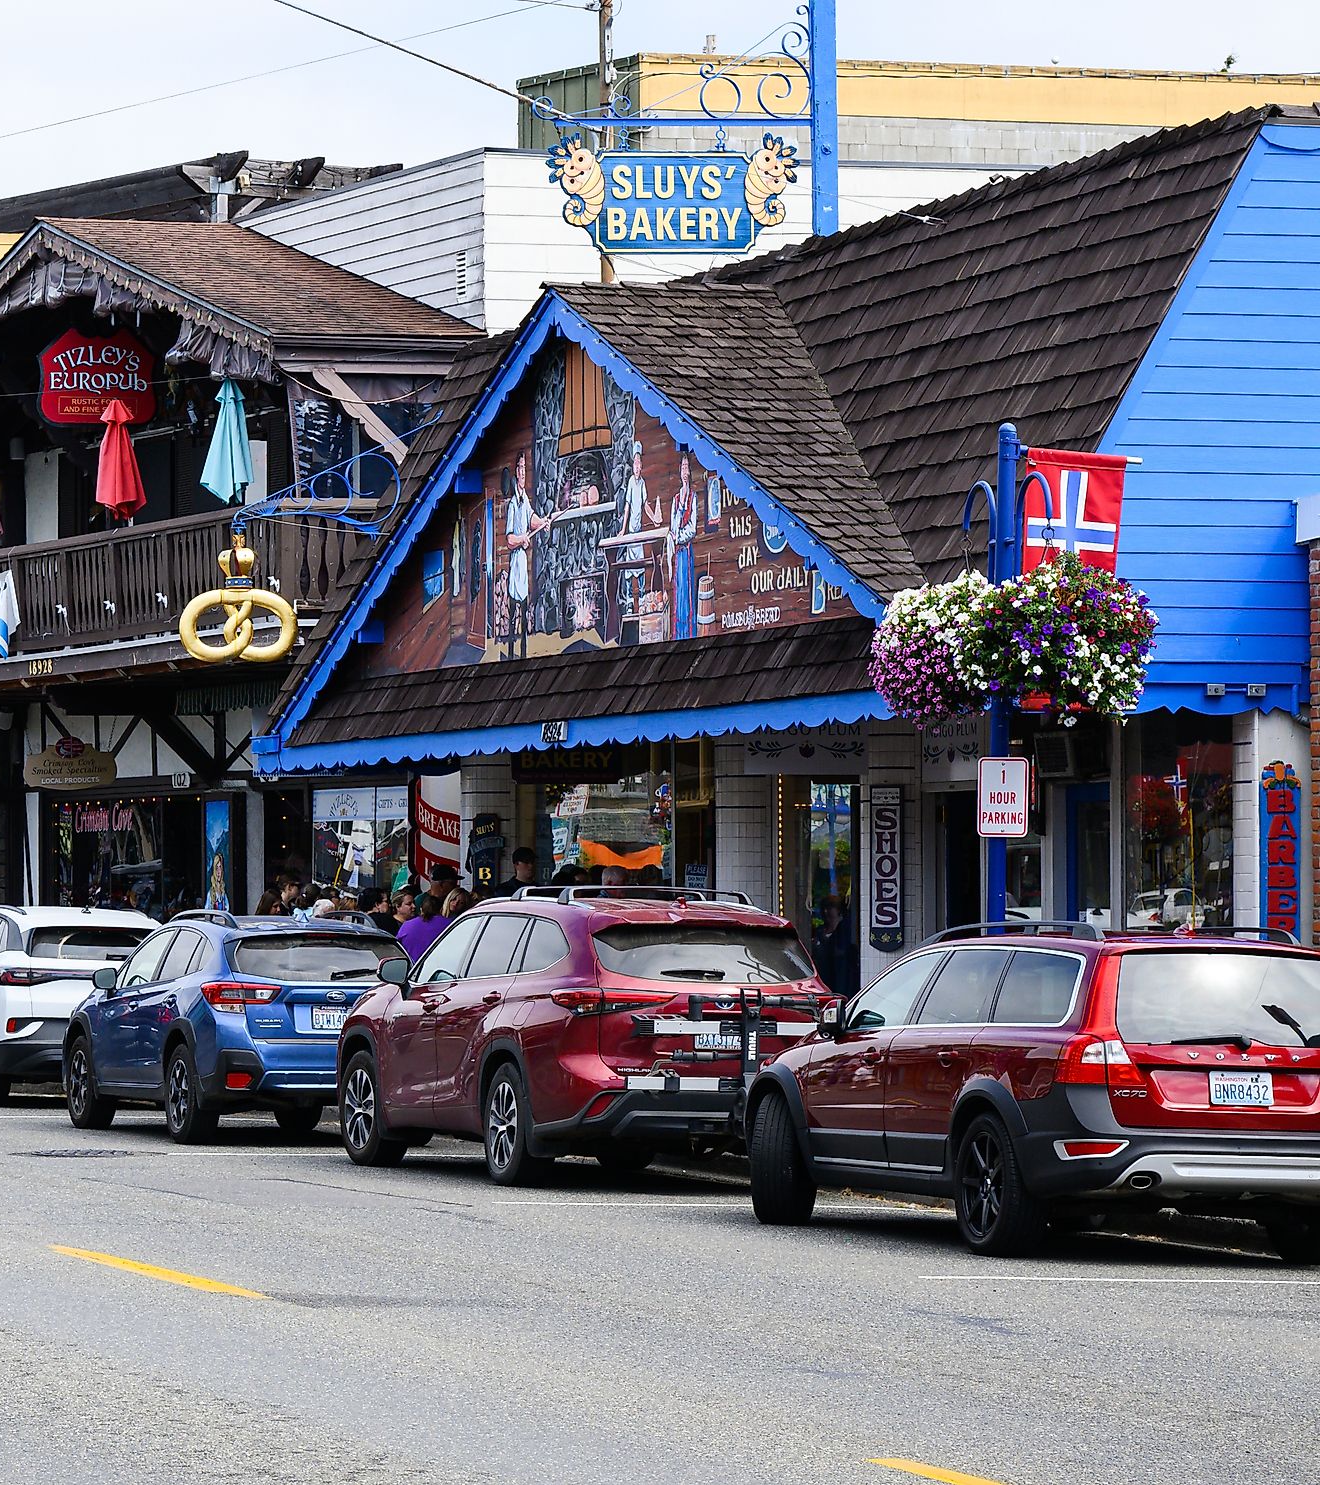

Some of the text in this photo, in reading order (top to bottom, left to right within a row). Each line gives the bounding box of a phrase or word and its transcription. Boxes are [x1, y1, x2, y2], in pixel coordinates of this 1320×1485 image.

[611, 164, 737, 200] SLUYS'
[606, 207, 743, 242] BAKERY
[52, 345, 141, 372] TIZLEY'S
[71, 398, 100, 406] RUSTIC
[29, 658, 53, 675] 18928
[818, 724, 861, 736] PLUM
[520, 751, 613, 769] BAKERY
[41, 776, 100, 785] LOCAL PRODUCTS
[173, 773, 188, 788] 102
[1001, 769, 1006, 785] 1
[989, 791, 1017, 805] HOUR
[981, 811, 1023, 825] PARKING
[875, 808, 898, 926] SHOES
[1267, 789, 1298, 934] BARBER
[748, 1030, 758, 1061] THULE
[1187, 1051, 1301, 1062] VOLVO
[1113, 1088, 1148, 1098] XC70
[1214, 1083, 1269, 1101] BNR8432
